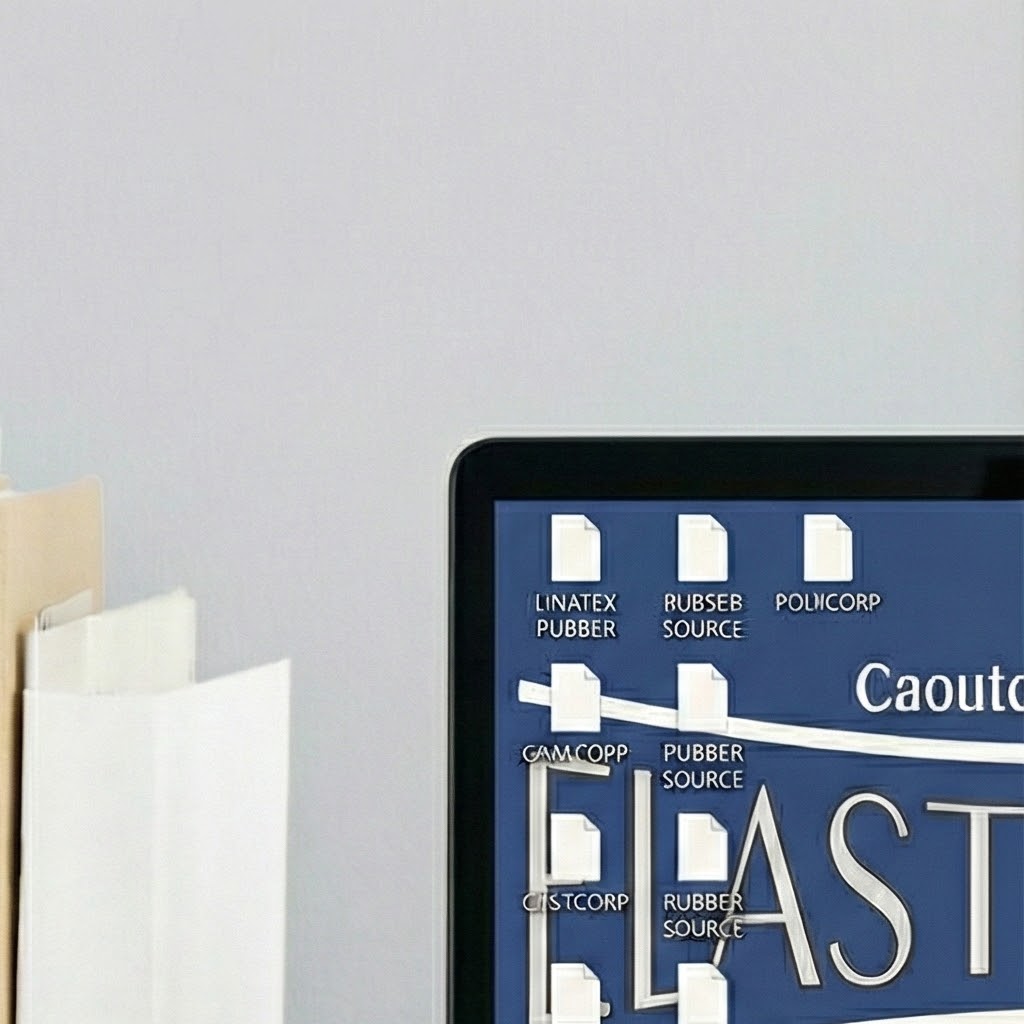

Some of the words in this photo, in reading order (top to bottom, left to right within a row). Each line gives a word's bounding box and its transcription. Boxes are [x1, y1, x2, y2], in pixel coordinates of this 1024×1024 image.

[535, 593, 617, 613] LINATEX
[536, 619, 616, 639] PUBBER
[663, 619, 744, 639] SOURCE
[664, 743, 744, 763] PUBBER
[662, 770, 743, 790] SOURCE
[664, 893, 744, 912] RUBBER
[663, 918, 745, 939] SOURCE
